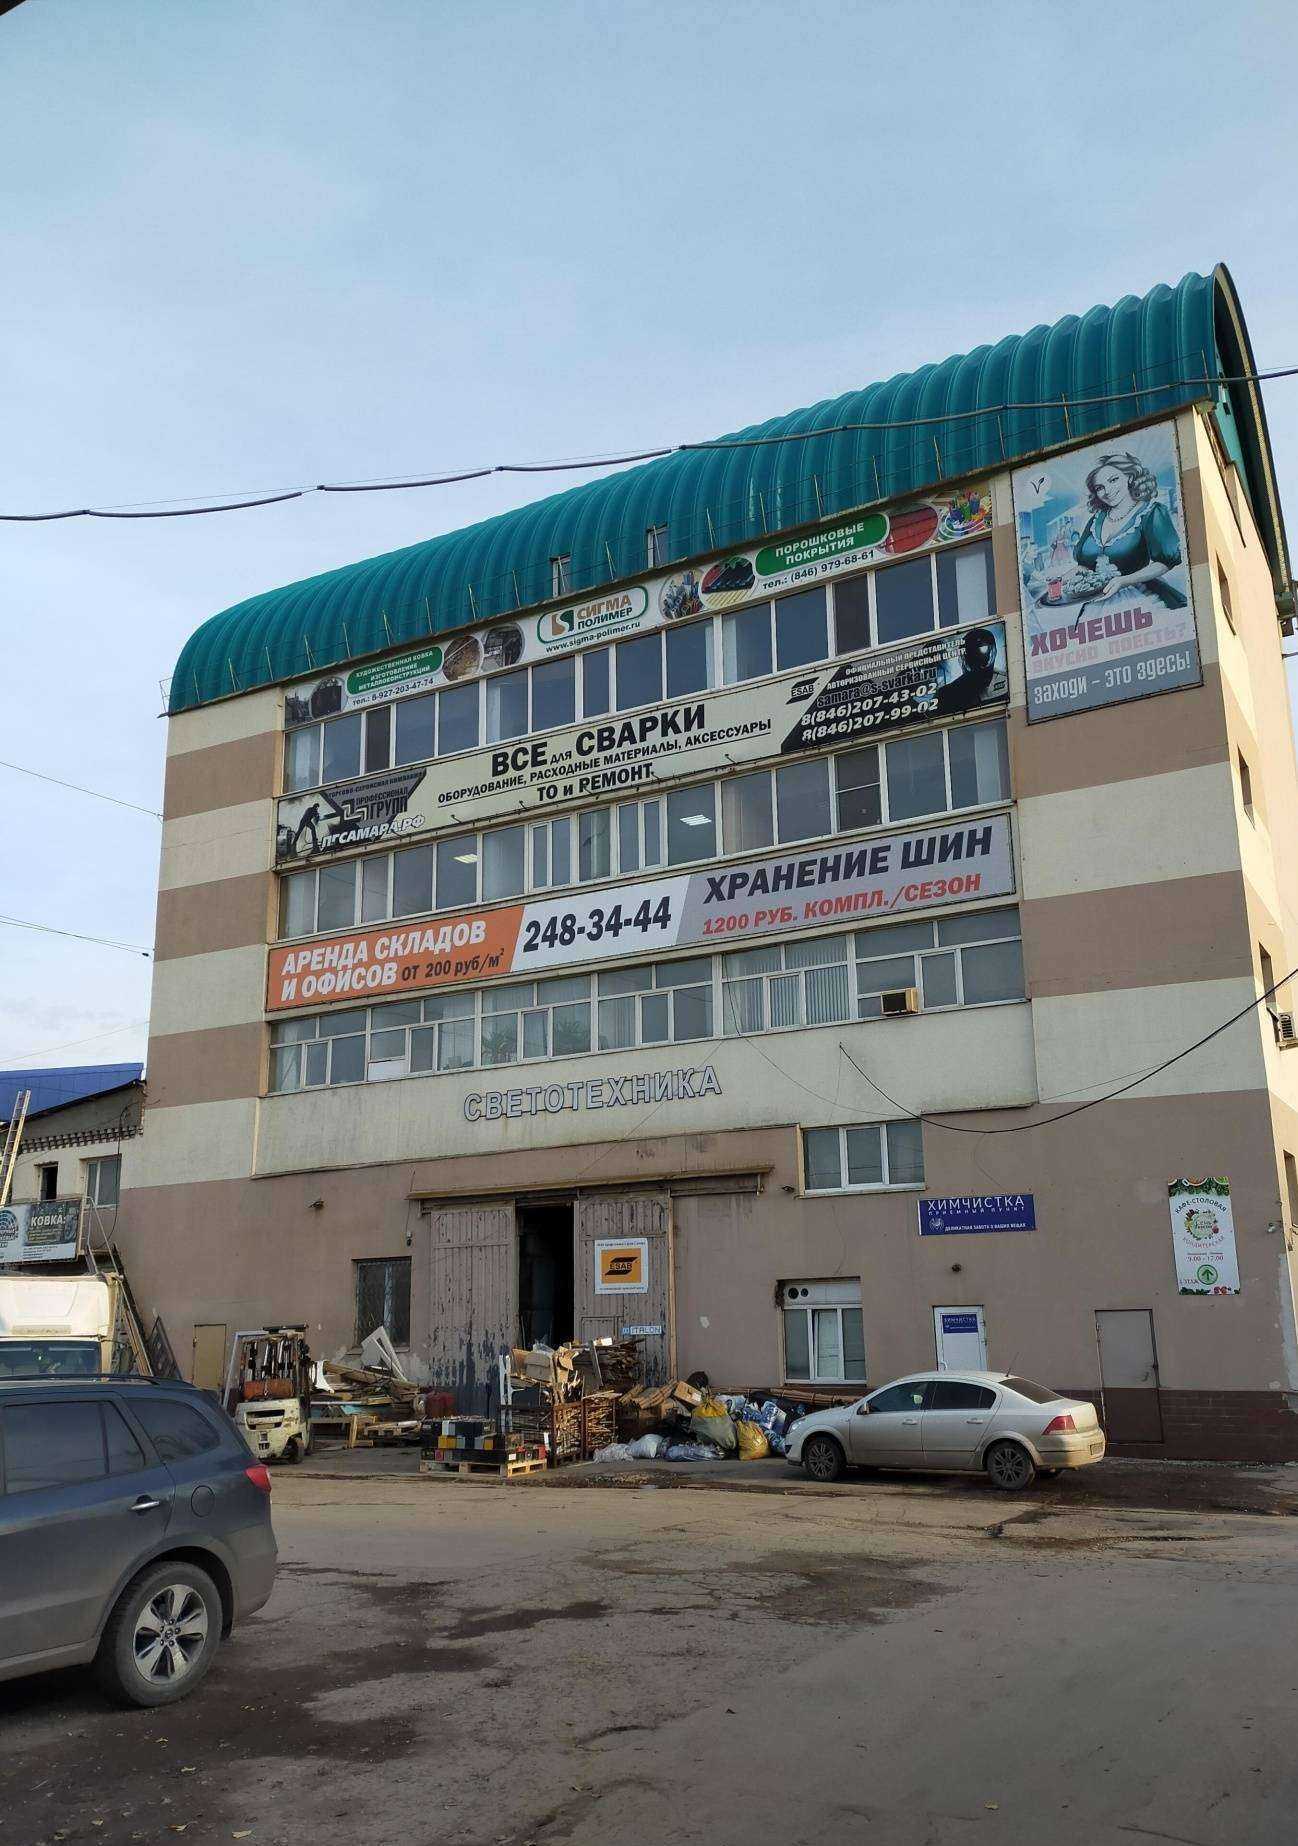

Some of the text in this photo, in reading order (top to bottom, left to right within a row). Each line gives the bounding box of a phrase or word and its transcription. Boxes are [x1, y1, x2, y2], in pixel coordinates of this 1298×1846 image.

[775, 522, 865, 557] ПОРОШКОВЫЕ
[785, 536, 855, 565] ПОКРЫТИЯ
[791, 567, 818, 583] (846)
[821, 551, 875, 573] 979-68-61
[576, 594, 632, 619] СИГМА
[577, 606, 633, 630] ПОЛИМЕР
[545, 621, 641, 653] www.sigma-polimer.ru
[1031, 607, 1153, 657] ХОЧЕШЬ
[370, 663, 418, 681] ИЗГОТОВЛЕНИЕ
[801, 683, 938, 727] 8(846)207-43-02
[491, 742, 548, 778] ВСЕ
[575, 704, 705, 757] СВАРКИ
[437, 719, 772, 804] ОБОРУДОВАНИЕ, РАСХОДНЫЕ МАТЕРИАЛЫ, АКСЕССУАРЫ
[537, 784, 558, 802] ТО
[579, 762, 653, 793] РЕМОНТ
[703, 826, 993, 904] ХРАНЕНИЕ ШИН
[523, 895, 672, 953] 248-34-44
[702, 915, 749, 936] 1200
[754, 906, 798, 928] РУБ.
[281, 920, 486, 976] АРЕНДА СКЛАДОВ
[281, 978, 297, 1001] И
[302, 962, 397, 998] ОФИСОВ
[425, 959, 451, 978] 200
[463, 1065, 722, 1122] СВЕТОТЕХНИКА
[928, 1196, 1025, 1211] ХИМЧИСТКА
[609, 1262, 633, 1271] ESAB
